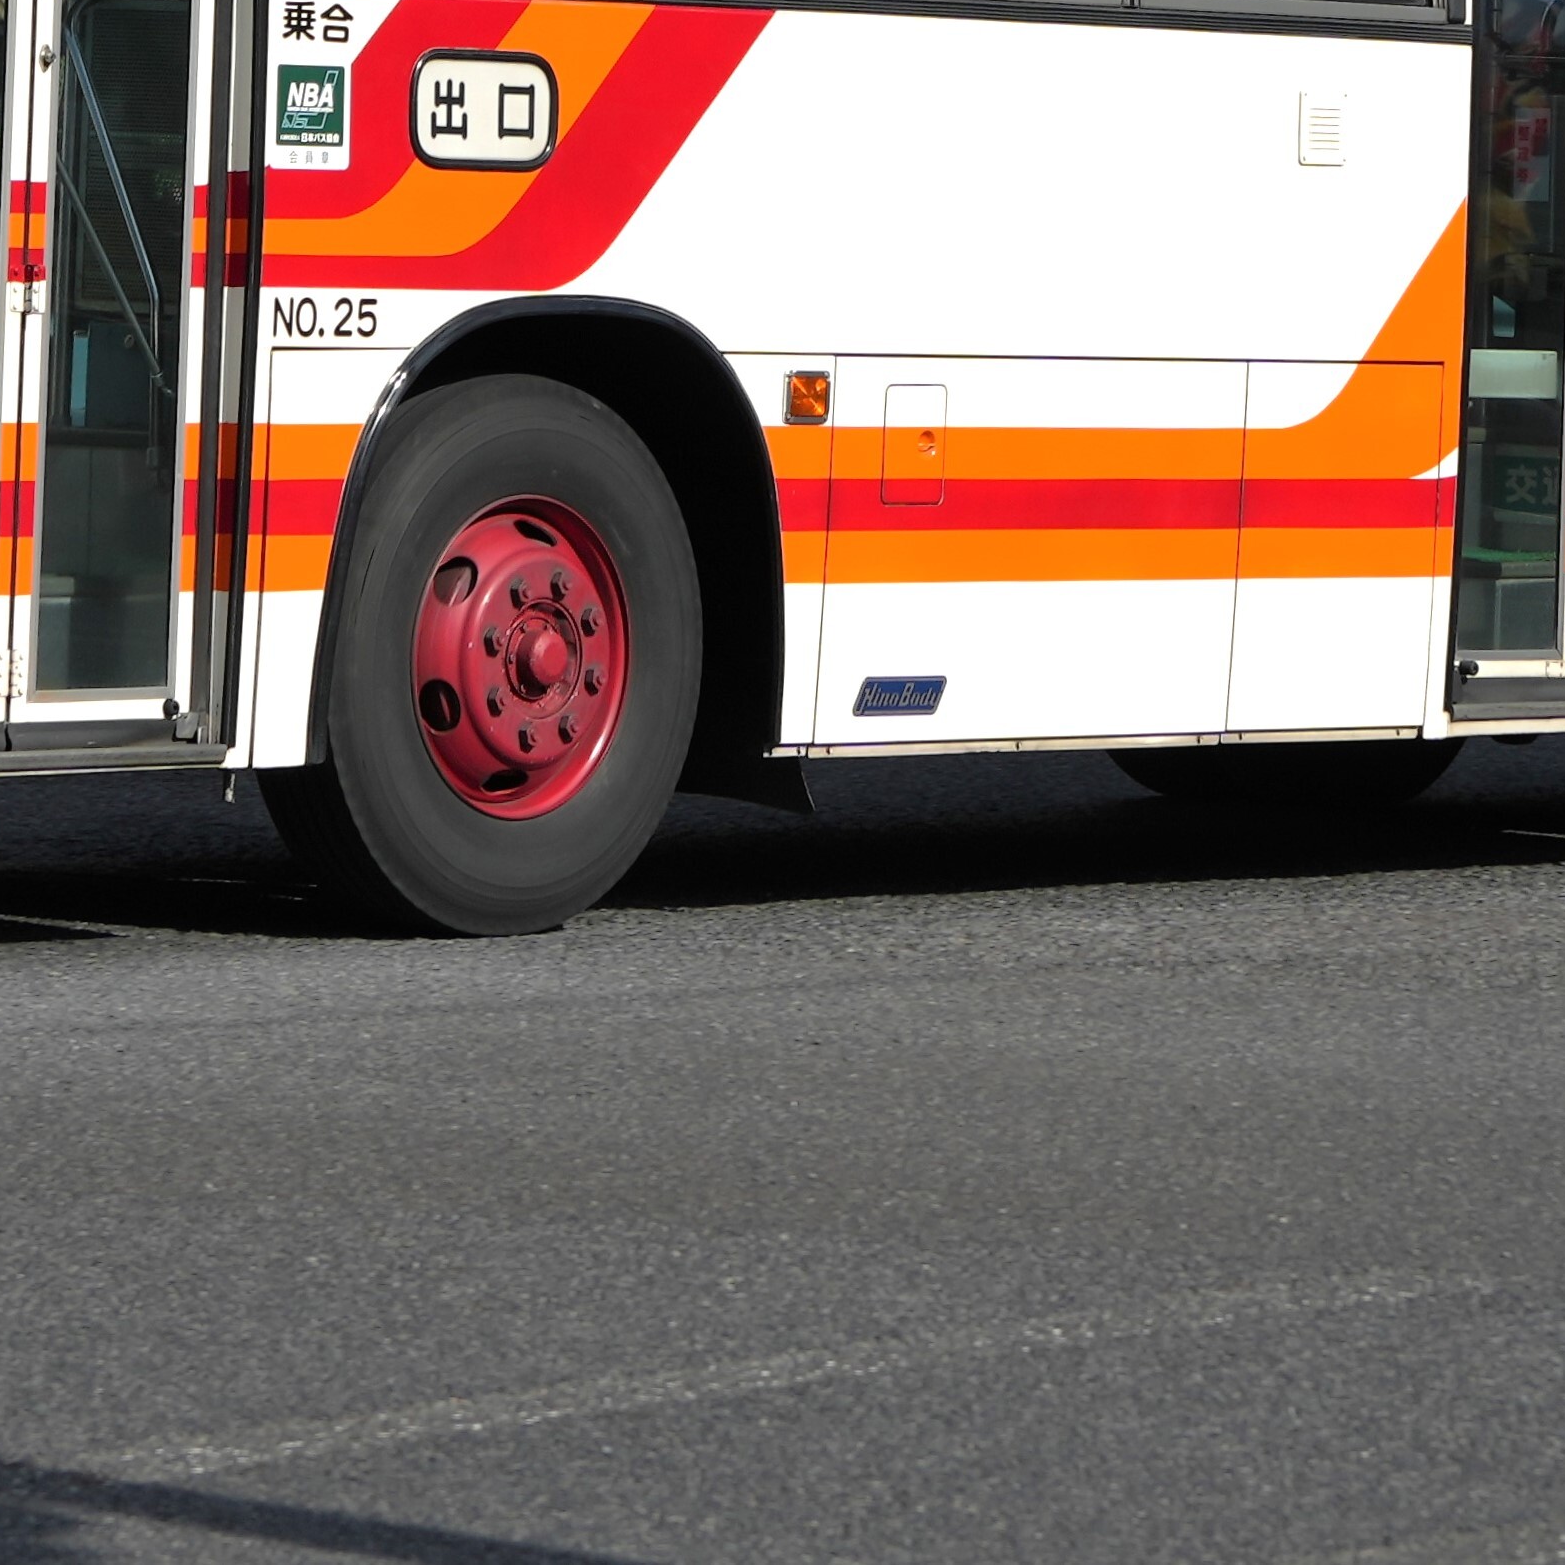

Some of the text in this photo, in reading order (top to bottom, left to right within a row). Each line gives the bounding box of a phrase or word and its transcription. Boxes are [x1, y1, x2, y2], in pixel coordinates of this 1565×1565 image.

[282, 1, 353, 43] 乗合
[287, 81, 334, 107] NBA
[430, 78, 535, 141] 出口
